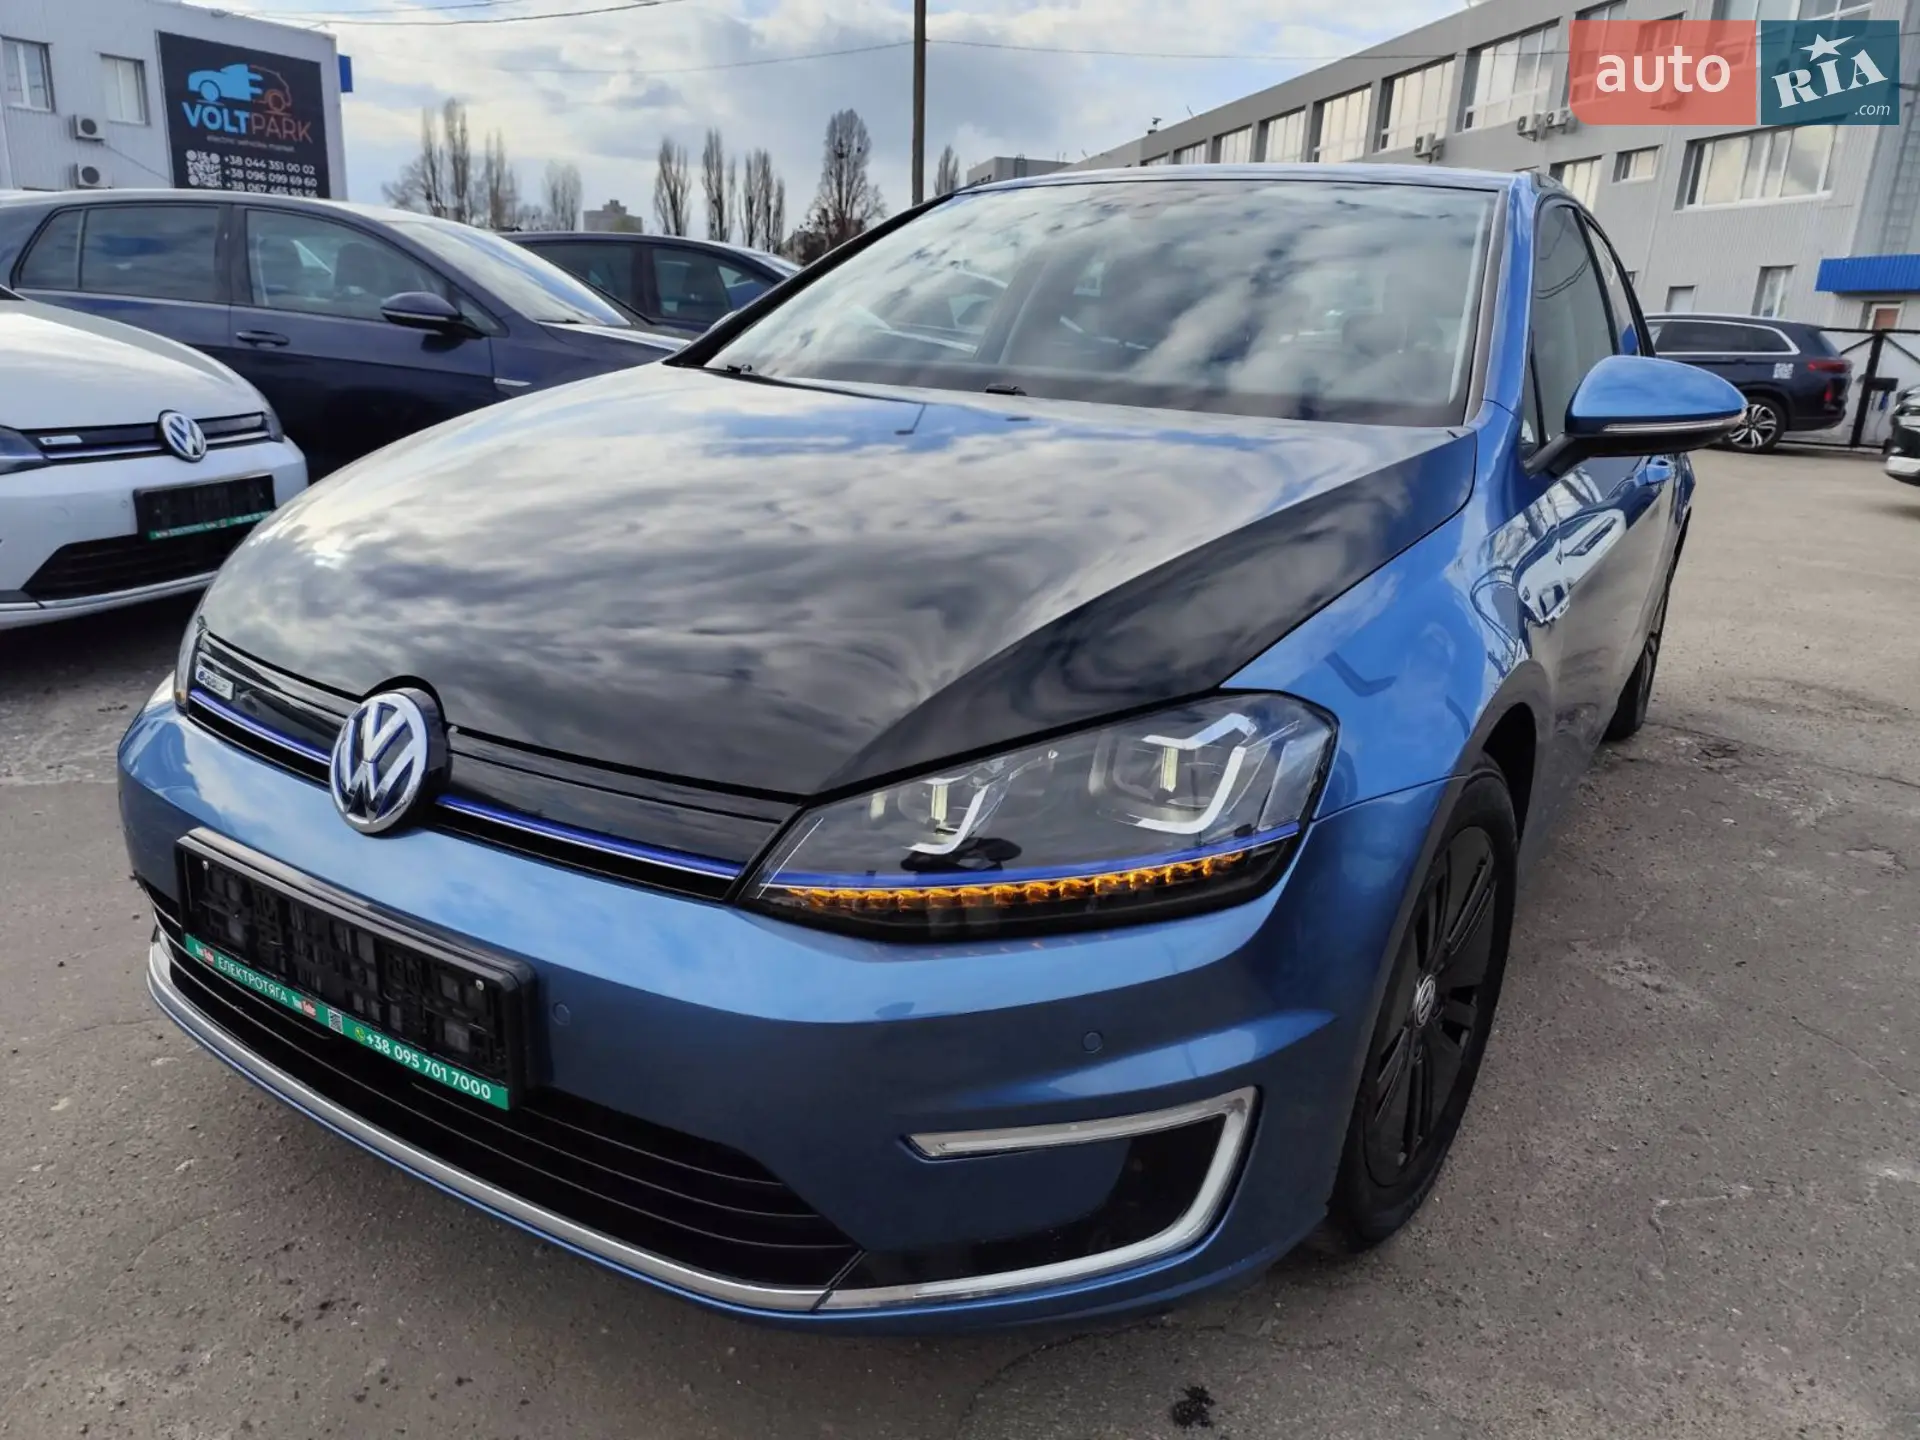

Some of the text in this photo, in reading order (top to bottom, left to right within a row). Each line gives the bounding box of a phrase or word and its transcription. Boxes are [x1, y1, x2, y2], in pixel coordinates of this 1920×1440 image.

[224, 154, 316, 175] +38 044 351 00 02
[225, 167, 244, 179] +38
[245, 170, 267, 181] 096
[218, 956, 288, 1003] ЕЛЕКТРОТЯГА
[366, 1033, 391, 1055] +38
[394, 1043, 420, 1069] 095
[423, 1058, 447, 1082] 701
[451, 1071, 491, 1099] 7000
